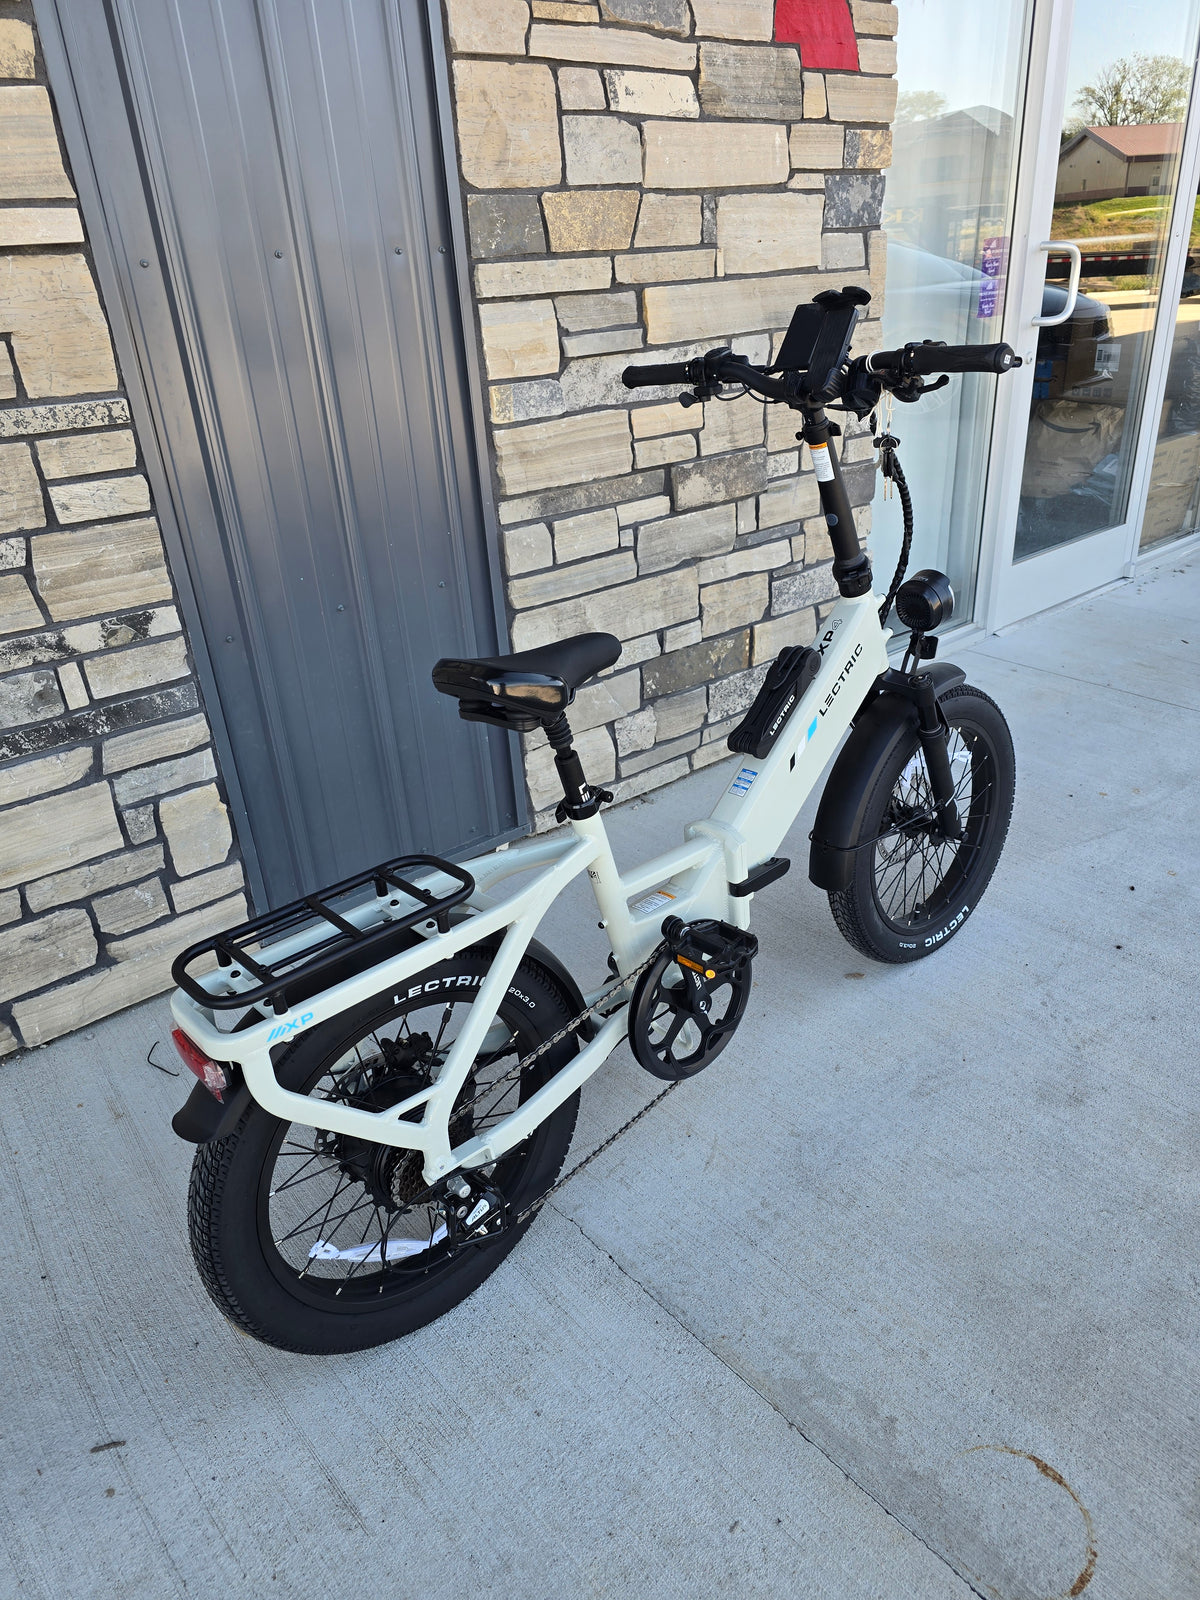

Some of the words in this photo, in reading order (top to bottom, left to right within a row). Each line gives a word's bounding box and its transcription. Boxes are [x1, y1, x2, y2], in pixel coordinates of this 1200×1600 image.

[818, 643, 864, 717] LECTRIC
[769, 694, 796, 736] LECTRIC
[924, 905, 970, 948] LECTRIC
[508, 986, 535, 1009] 20x3.0
